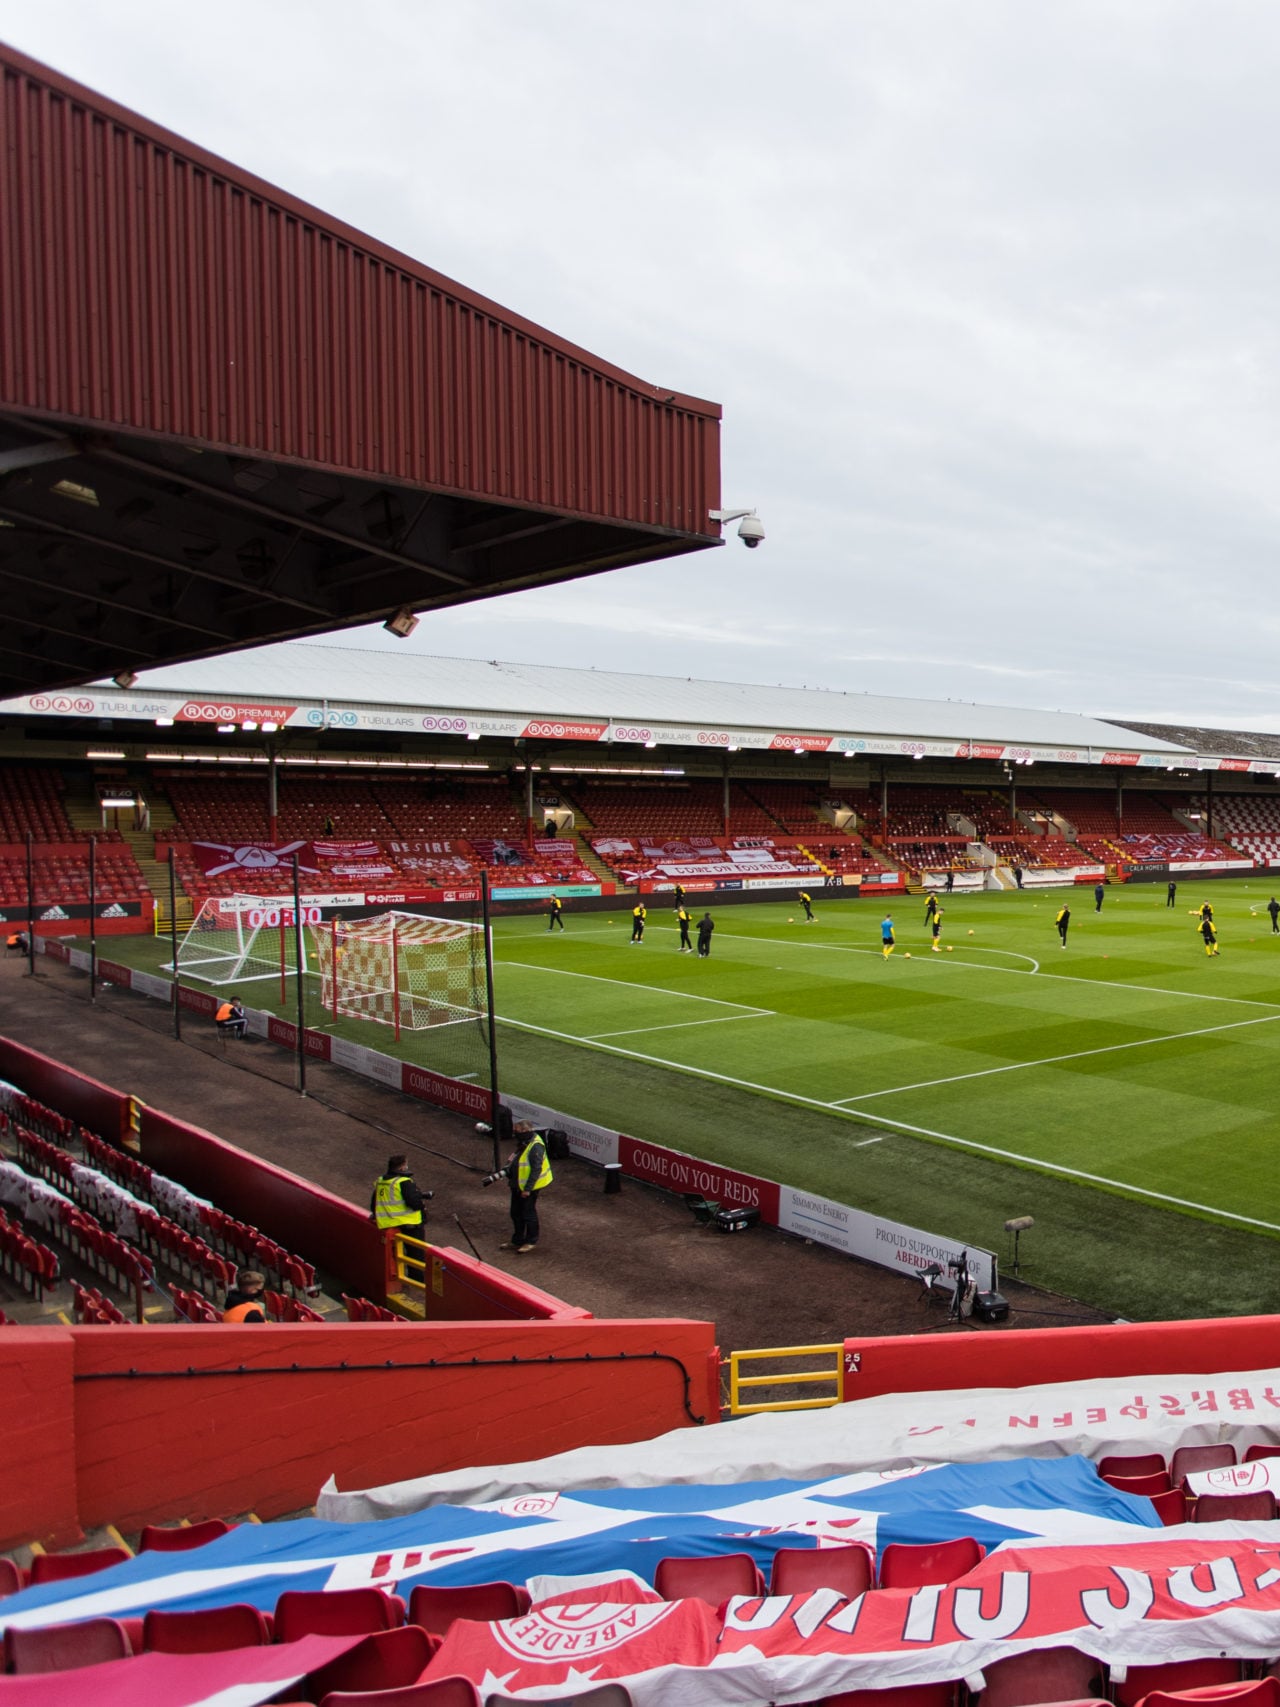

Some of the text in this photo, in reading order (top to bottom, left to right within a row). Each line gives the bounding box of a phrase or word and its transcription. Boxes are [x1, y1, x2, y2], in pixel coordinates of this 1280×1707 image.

[31, 696, 167, 714] RAM TUBULARS
[184, 704, 287, 720] RAM PREMIUM
[308, 710, 415, 727] RAM TUBULARS
[423, 717, 517, 731] RAM TUBULARS
[528, 723, 600, 736] RAM PREMIUM
[616, 728, 691, 741] RAM TUBULARS
[697, 732, 766, 745] RAM TUBULARS
[774, 736, 801, 747] RAM
[676, 866, 709, 874] COME
[761, 862, 792, 870] REDS
[410, 1073, 487, 1112] COME ON YOU REDS
[567, 1135, 591, 1152] BERDEEN
[633, 1149, 760, 1207] COME ON YOU REDS
[792, 1193, 849, 1223] SIMMONS ENERGY
[876, 1227, 907, 1249] PROUD
[844, 1353, 860, 1363] 25
[847, 1362, 858, 1373] A
[509, 1610, 637, 1652] ABERDEE
